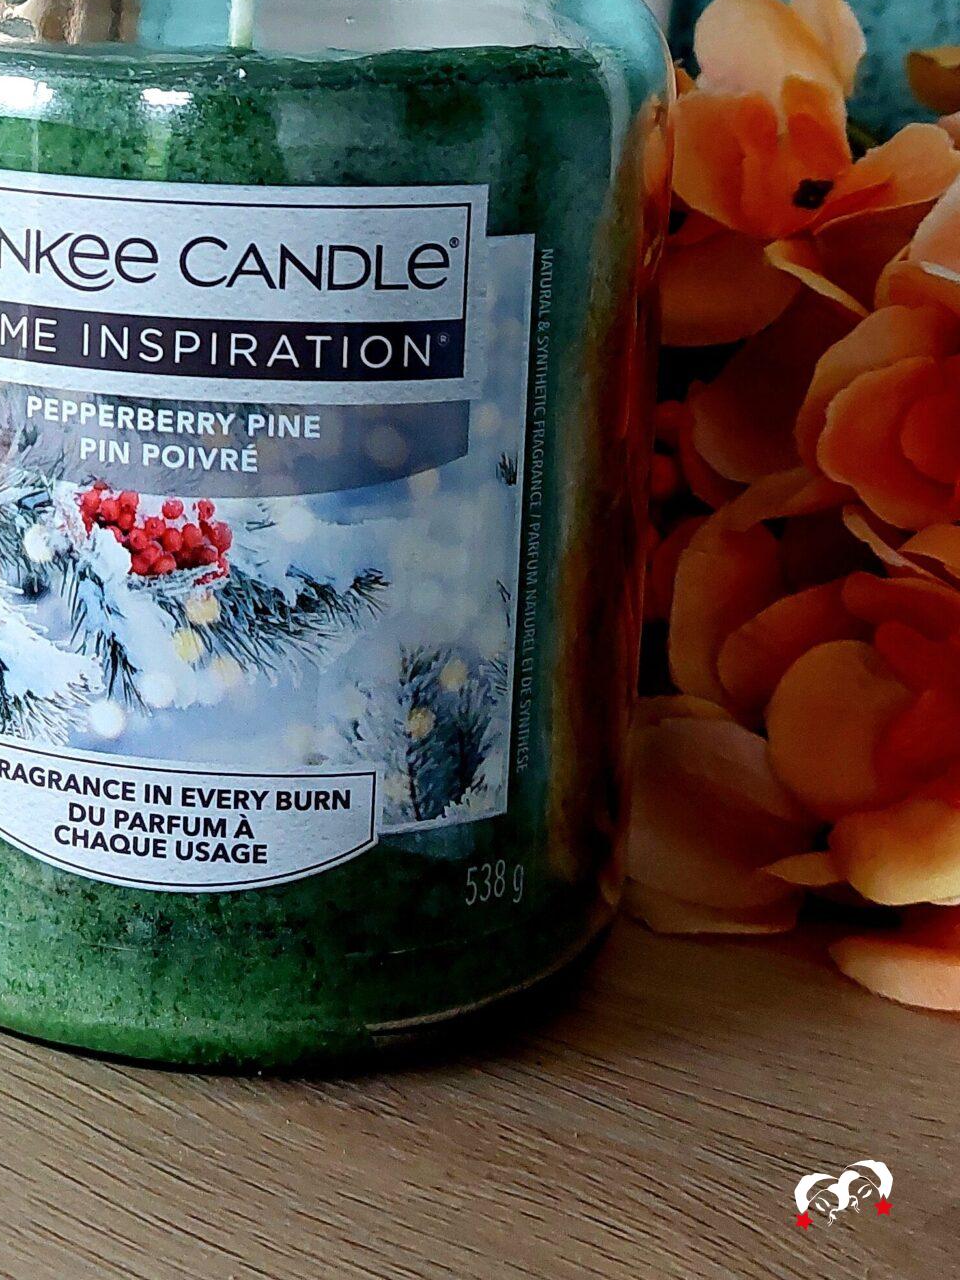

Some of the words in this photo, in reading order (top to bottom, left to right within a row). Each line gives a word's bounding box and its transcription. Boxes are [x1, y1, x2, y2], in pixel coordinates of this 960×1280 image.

[538, 248, 553, 316] NATURAL
[534, 334, 550, 416] SYNTHETIC
[26, 394, 236, 436] PEPPERBERRY
[247, 413, 321, 439] PINE
[79, 437, 130, 465] PIN
[142, 443, 259, 473] POIVRÉ
[529, 420, 546, 507] FRAGRANCE
[68, 801, 106, 827] DU
[113, 809, 228, 838] PARFUM
[233, 814, 255, 839] À
[144, 784, 172, 806] IN
[181, 787, 268, 811] EVERY
[275, 789, 351, 811] BURN
[54, 824, 168, 861] CHAQUE
[175, 840, 268, 864] USAGE
[465, 859, 506, 906] 538
[512, 864, 524, 903] g
